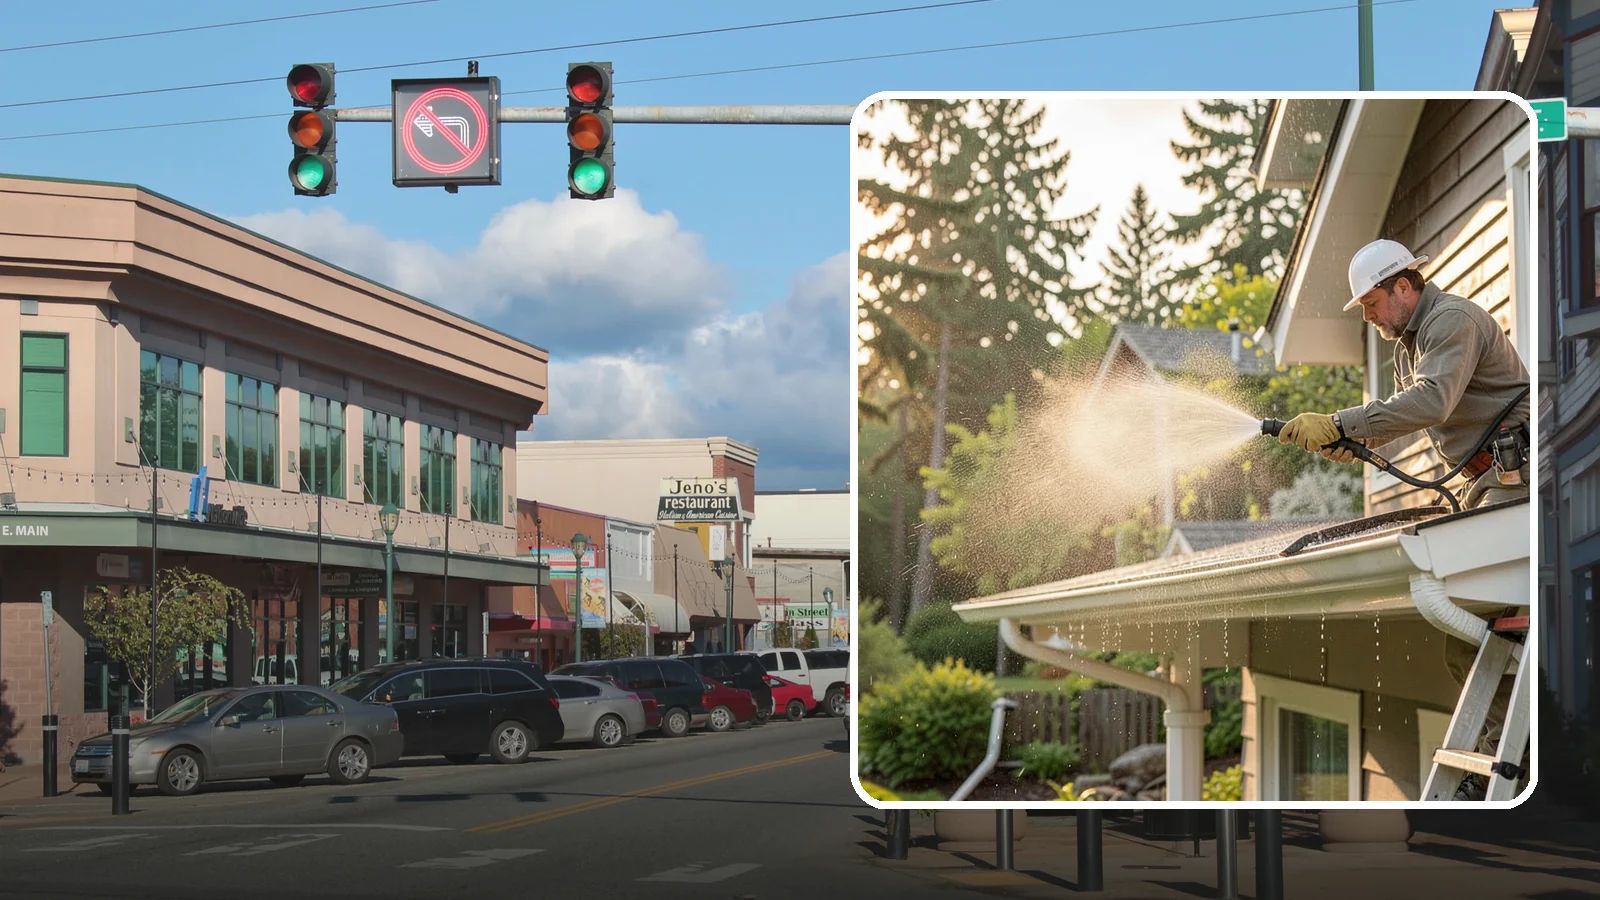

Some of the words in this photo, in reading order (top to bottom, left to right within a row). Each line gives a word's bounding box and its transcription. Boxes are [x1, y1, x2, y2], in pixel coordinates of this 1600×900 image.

[669, 480, 728, 495] Jeno's
[665, 497, 731, 509] restaurant
[658, 510, 681, 520] Italian
[686, 510, 714, 519] American
[715, 510, 738, 519] Cuisine
[2, 525, 13, 536] E.
[15, 525, 49, 536] MAIN
[797, 607, 829, 617] Street
[790, 619, 824, 628] lass
